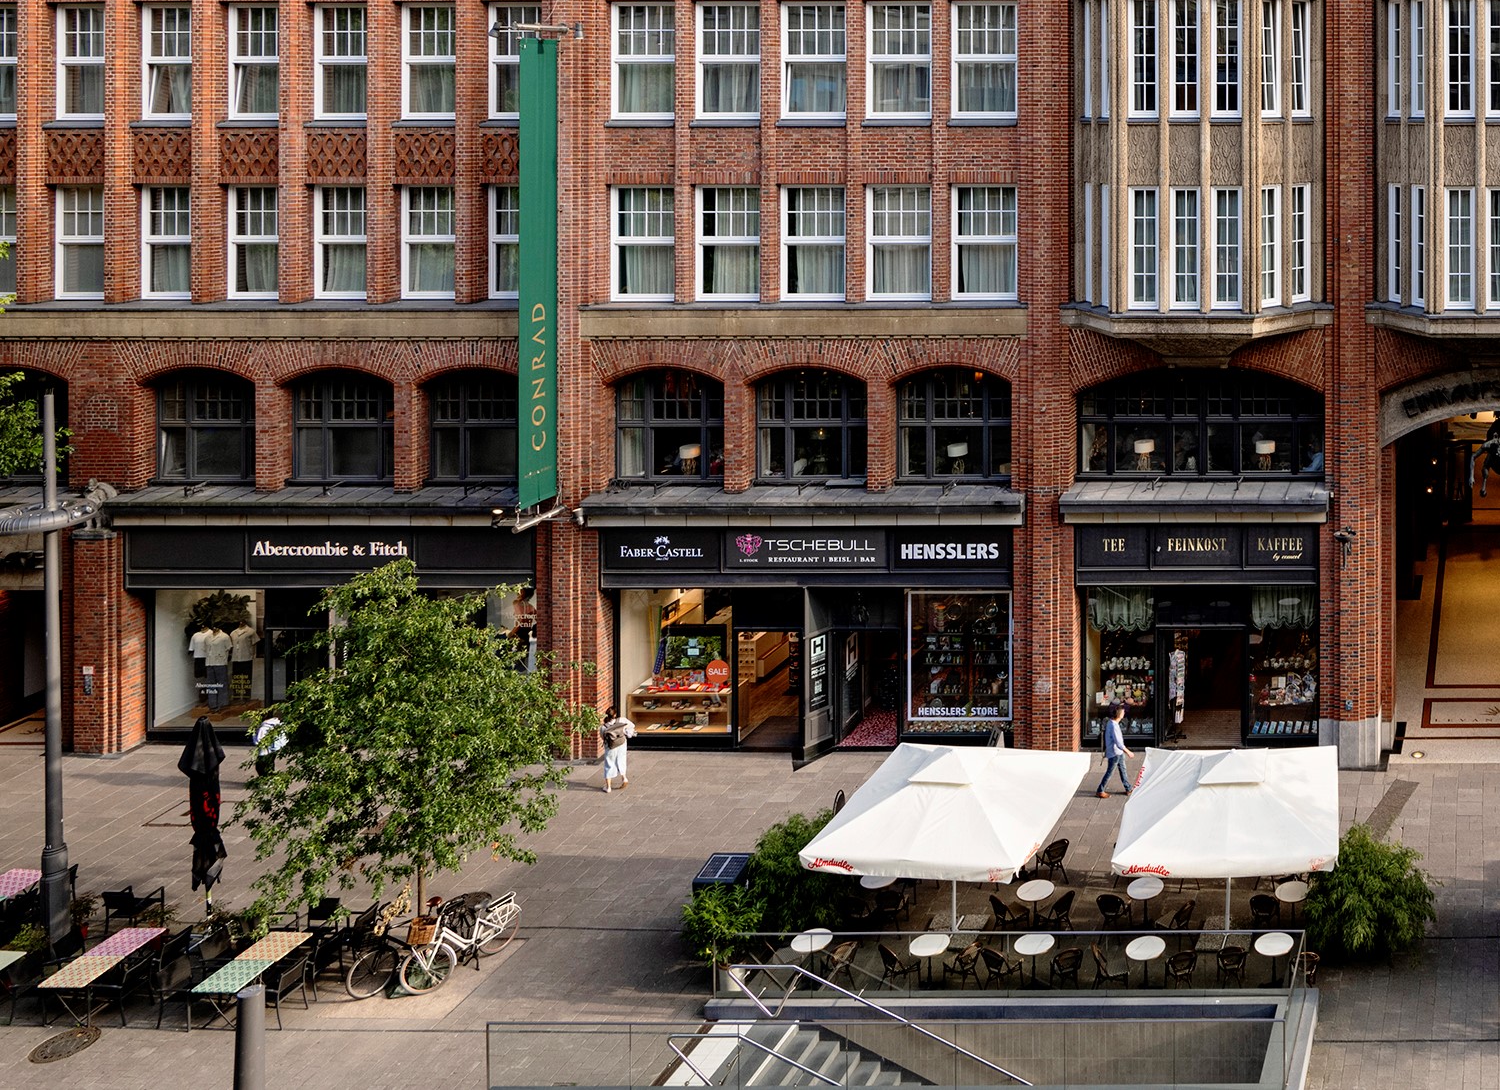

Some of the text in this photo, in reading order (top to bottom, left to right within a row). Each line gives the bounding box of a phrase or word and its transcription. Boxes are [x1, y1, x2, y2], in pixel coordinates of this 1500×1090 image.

[531, 303, 546, 451] CONRAD
[252, 541, 408, 557] Abercrombie & Fitch
[764, 539, 876, 551] TSCHEBULL
[901, 543, 999, 559] HENSSLERS
[1103, 538, 1126, 552] TEE
[1167, 537, 1227, 552] FEINKOST
[1257, 537, 1303, 551] KAFFEE
[1272, 552, 1280, 561] by
[708, 668, 728, 676] SALE
[918, 707, 998, 716] HENSSLERS STORE
[807, 857, 855, 873] Almdudler
[1121, 864, 1170, 877] Almdudler
